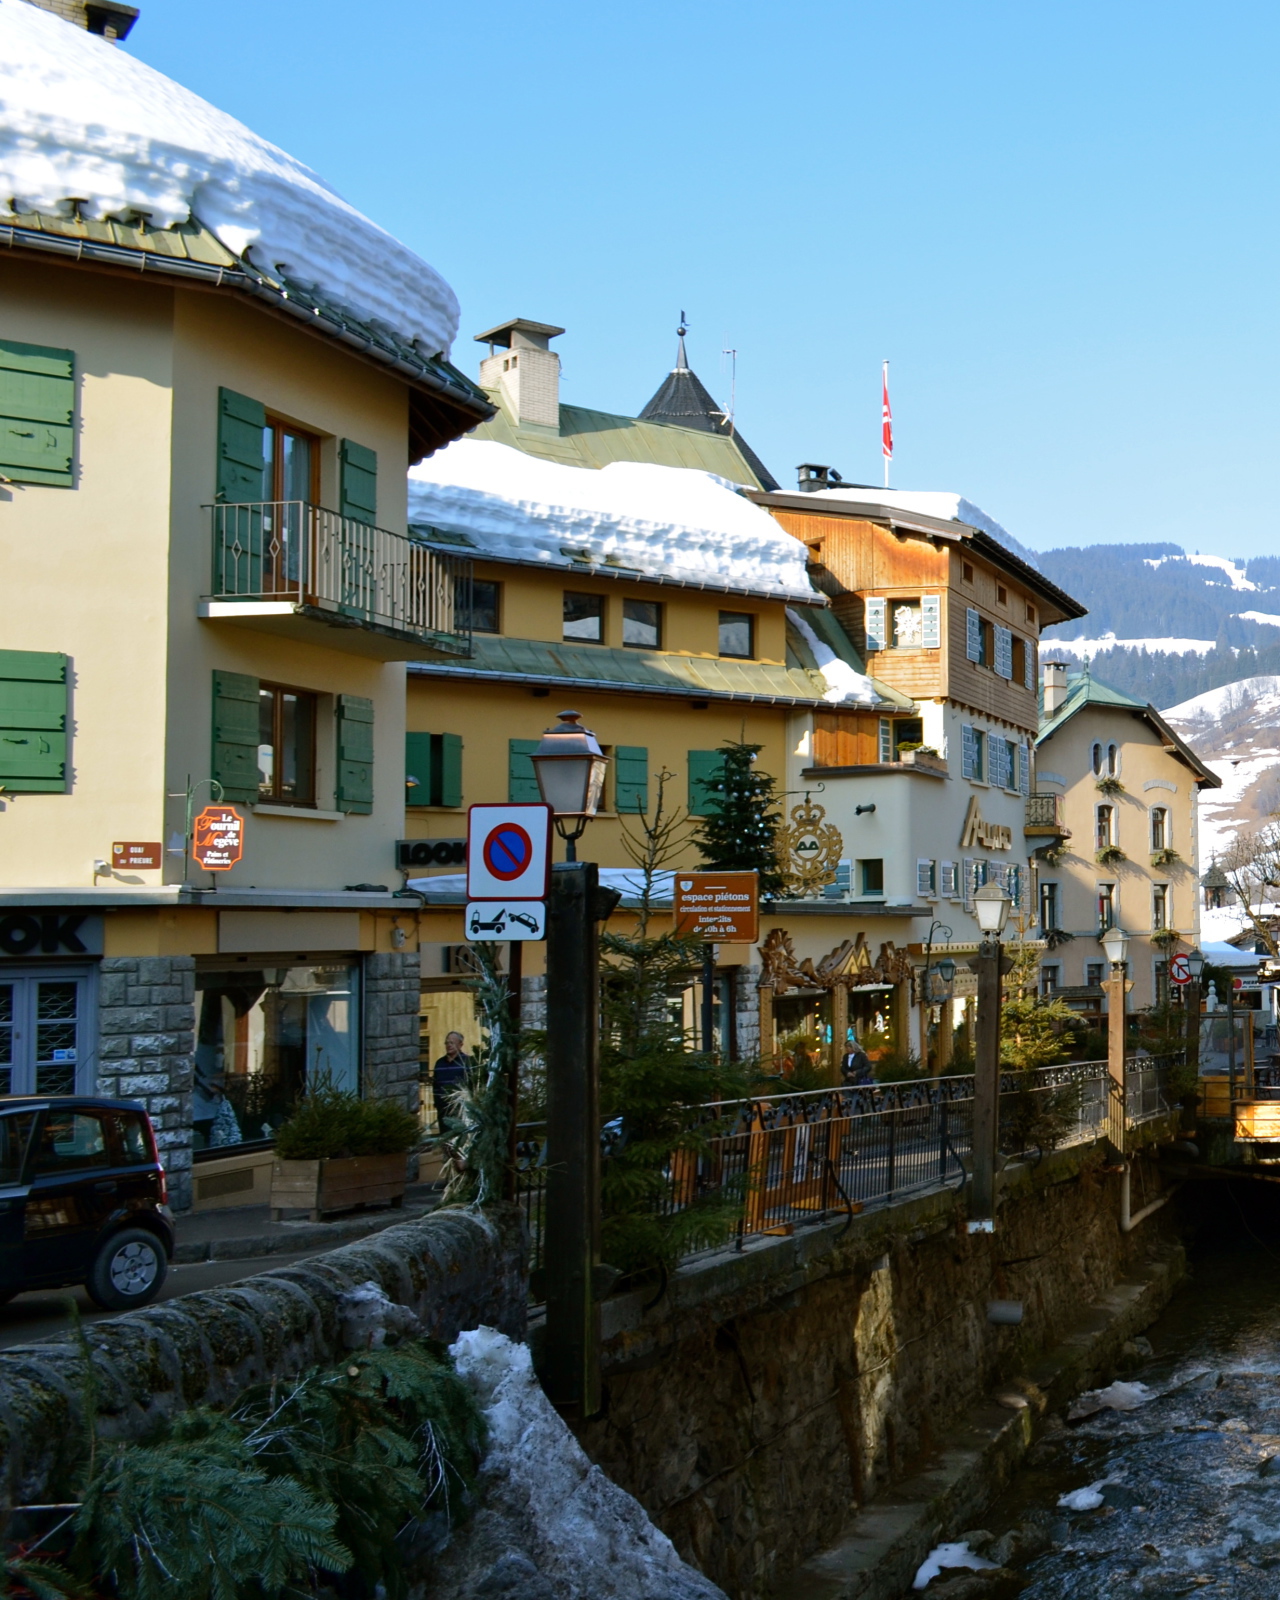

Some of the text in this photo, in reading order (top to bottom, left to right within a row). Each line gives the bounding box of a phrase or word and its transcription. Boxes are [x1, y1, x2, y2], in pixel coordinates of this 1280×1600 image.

[221, 813, 233, 822] Le
[197, 815, 240, 831] Fournil
[226, 831, 237, 839] de
[130, 846, 145, 854] QUAI
[682, 892, 749, 903] espace piétons
[726, 925, 737, 933] 6h
